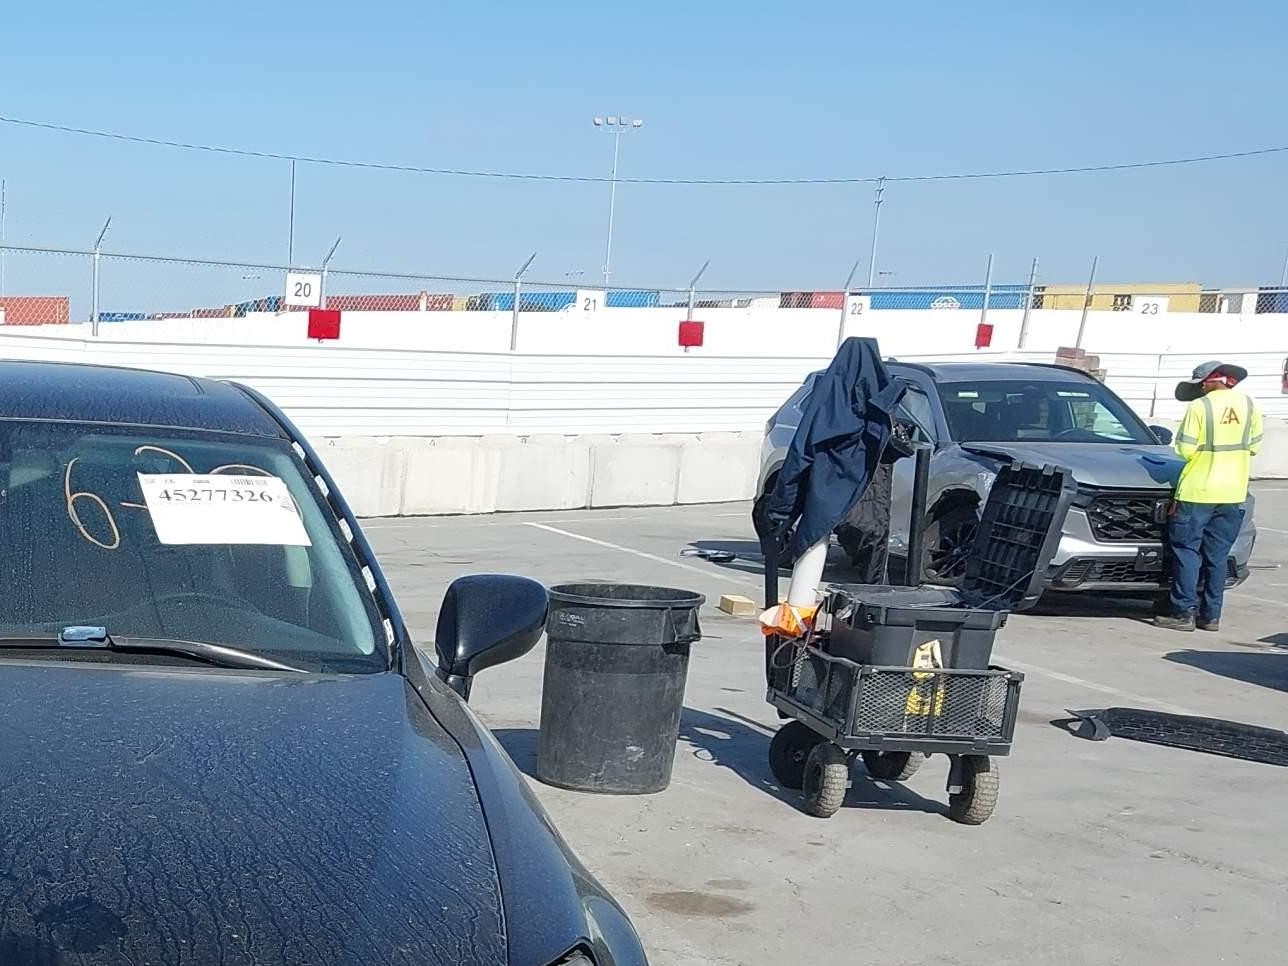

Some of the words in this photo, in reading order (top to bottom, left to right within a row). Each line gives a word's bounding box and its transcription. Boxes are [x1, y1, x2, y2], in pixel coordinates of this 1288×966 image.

[293, 281, 312, 298] 20
[583, 297, 598, 313] 21
[850, 302, 864, 316] 22
[1140, 302, 1160, 316] 23
[158, 488, 273, 503] 45277326
